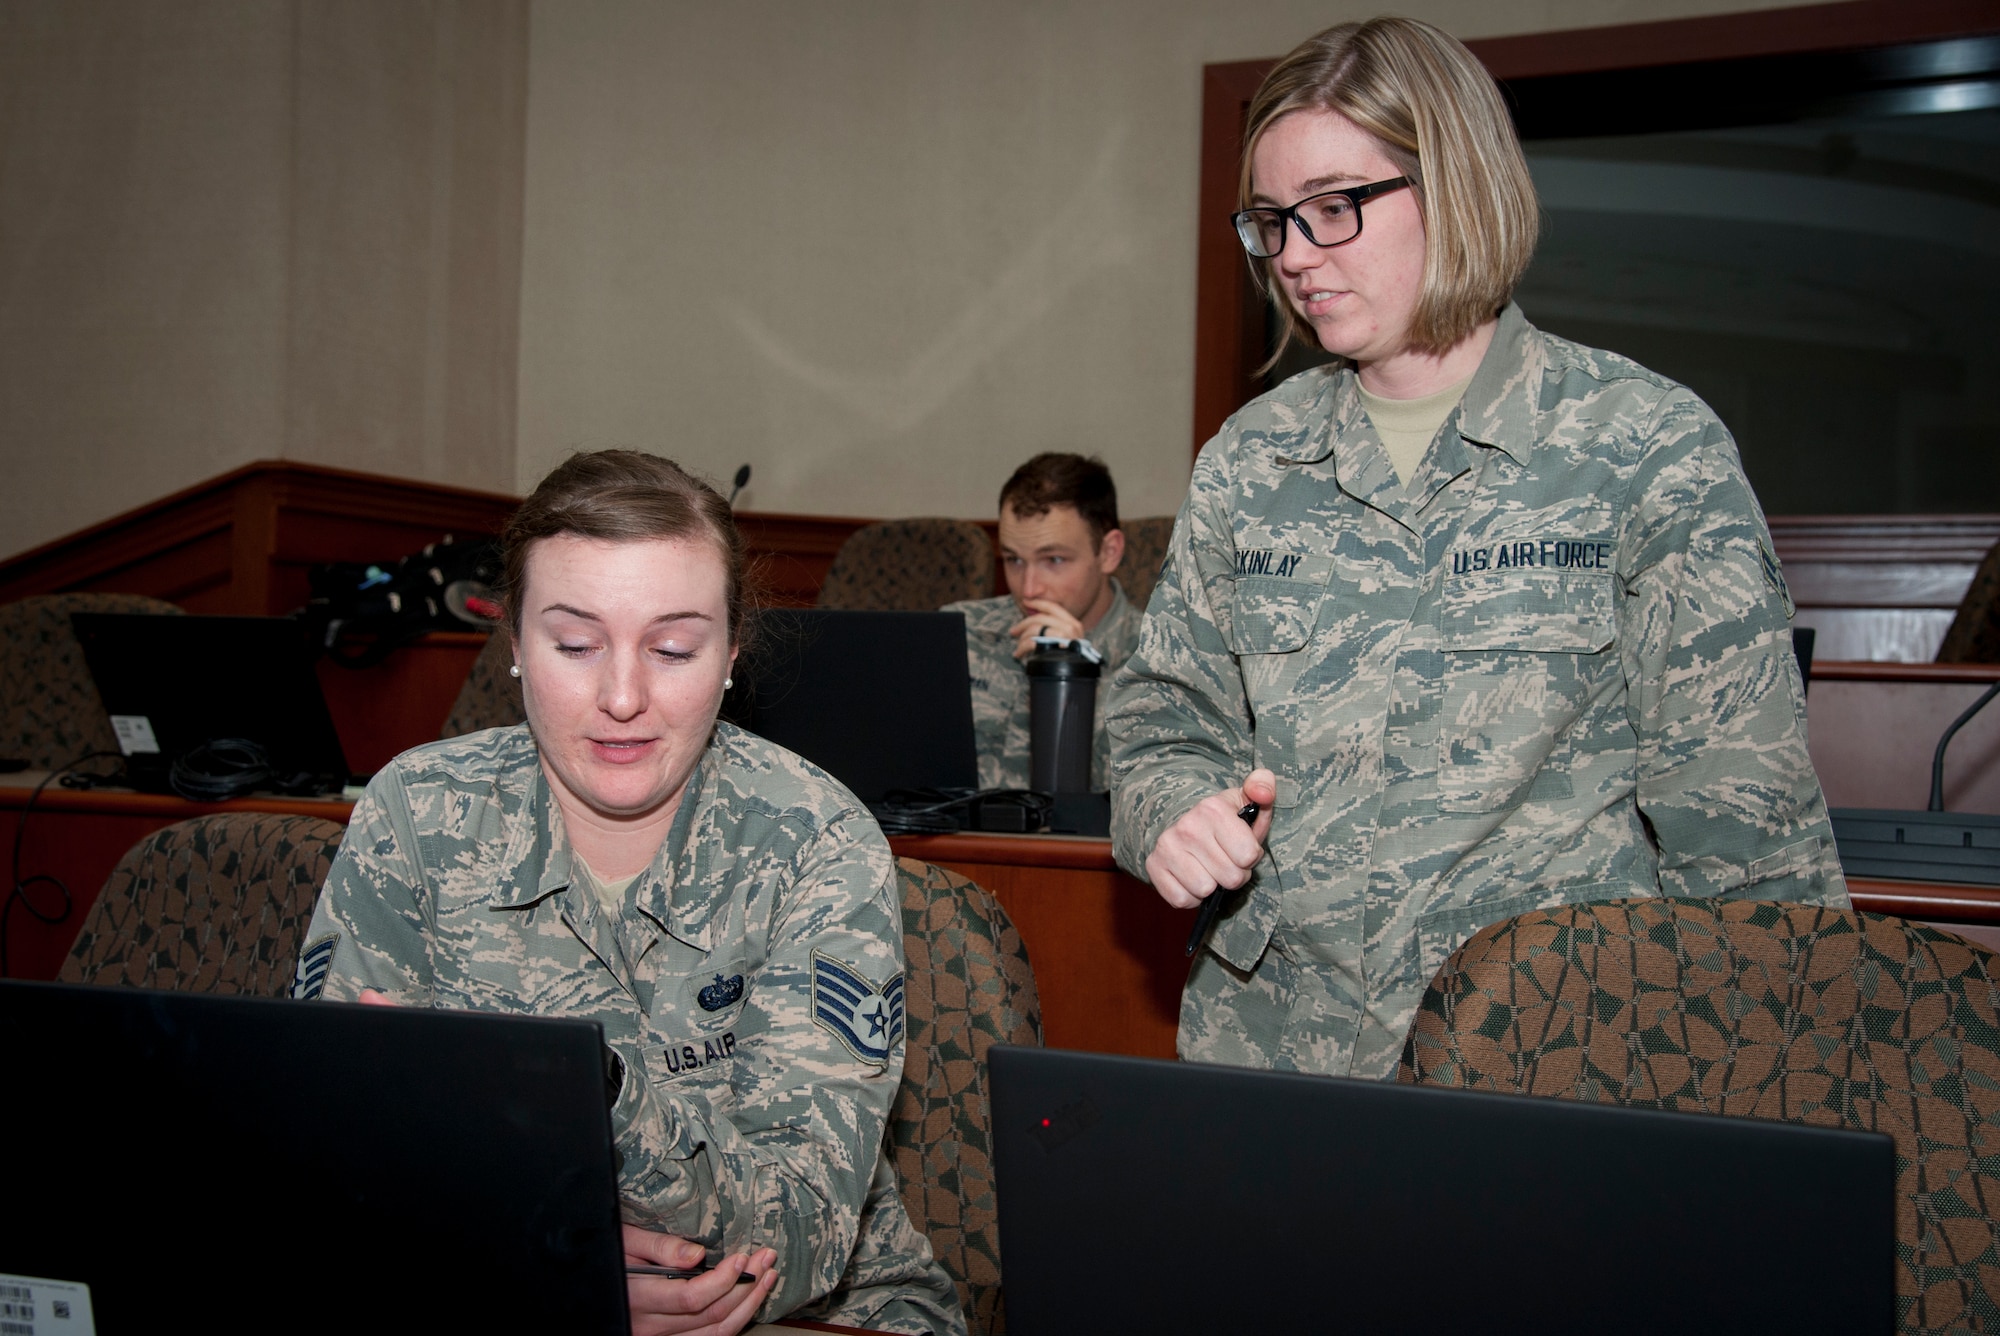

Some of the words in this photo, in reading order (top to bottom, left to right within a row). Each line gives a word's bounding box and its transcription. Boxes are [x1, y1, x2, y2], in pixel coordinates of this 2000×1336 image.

[1453, 549, 1491, 575] U.S.
[1497, 542, 1535, 568] AIR
[1540, 541, 1611, 569] FORCE
[664, 1046, 703, 1073] U.S.
